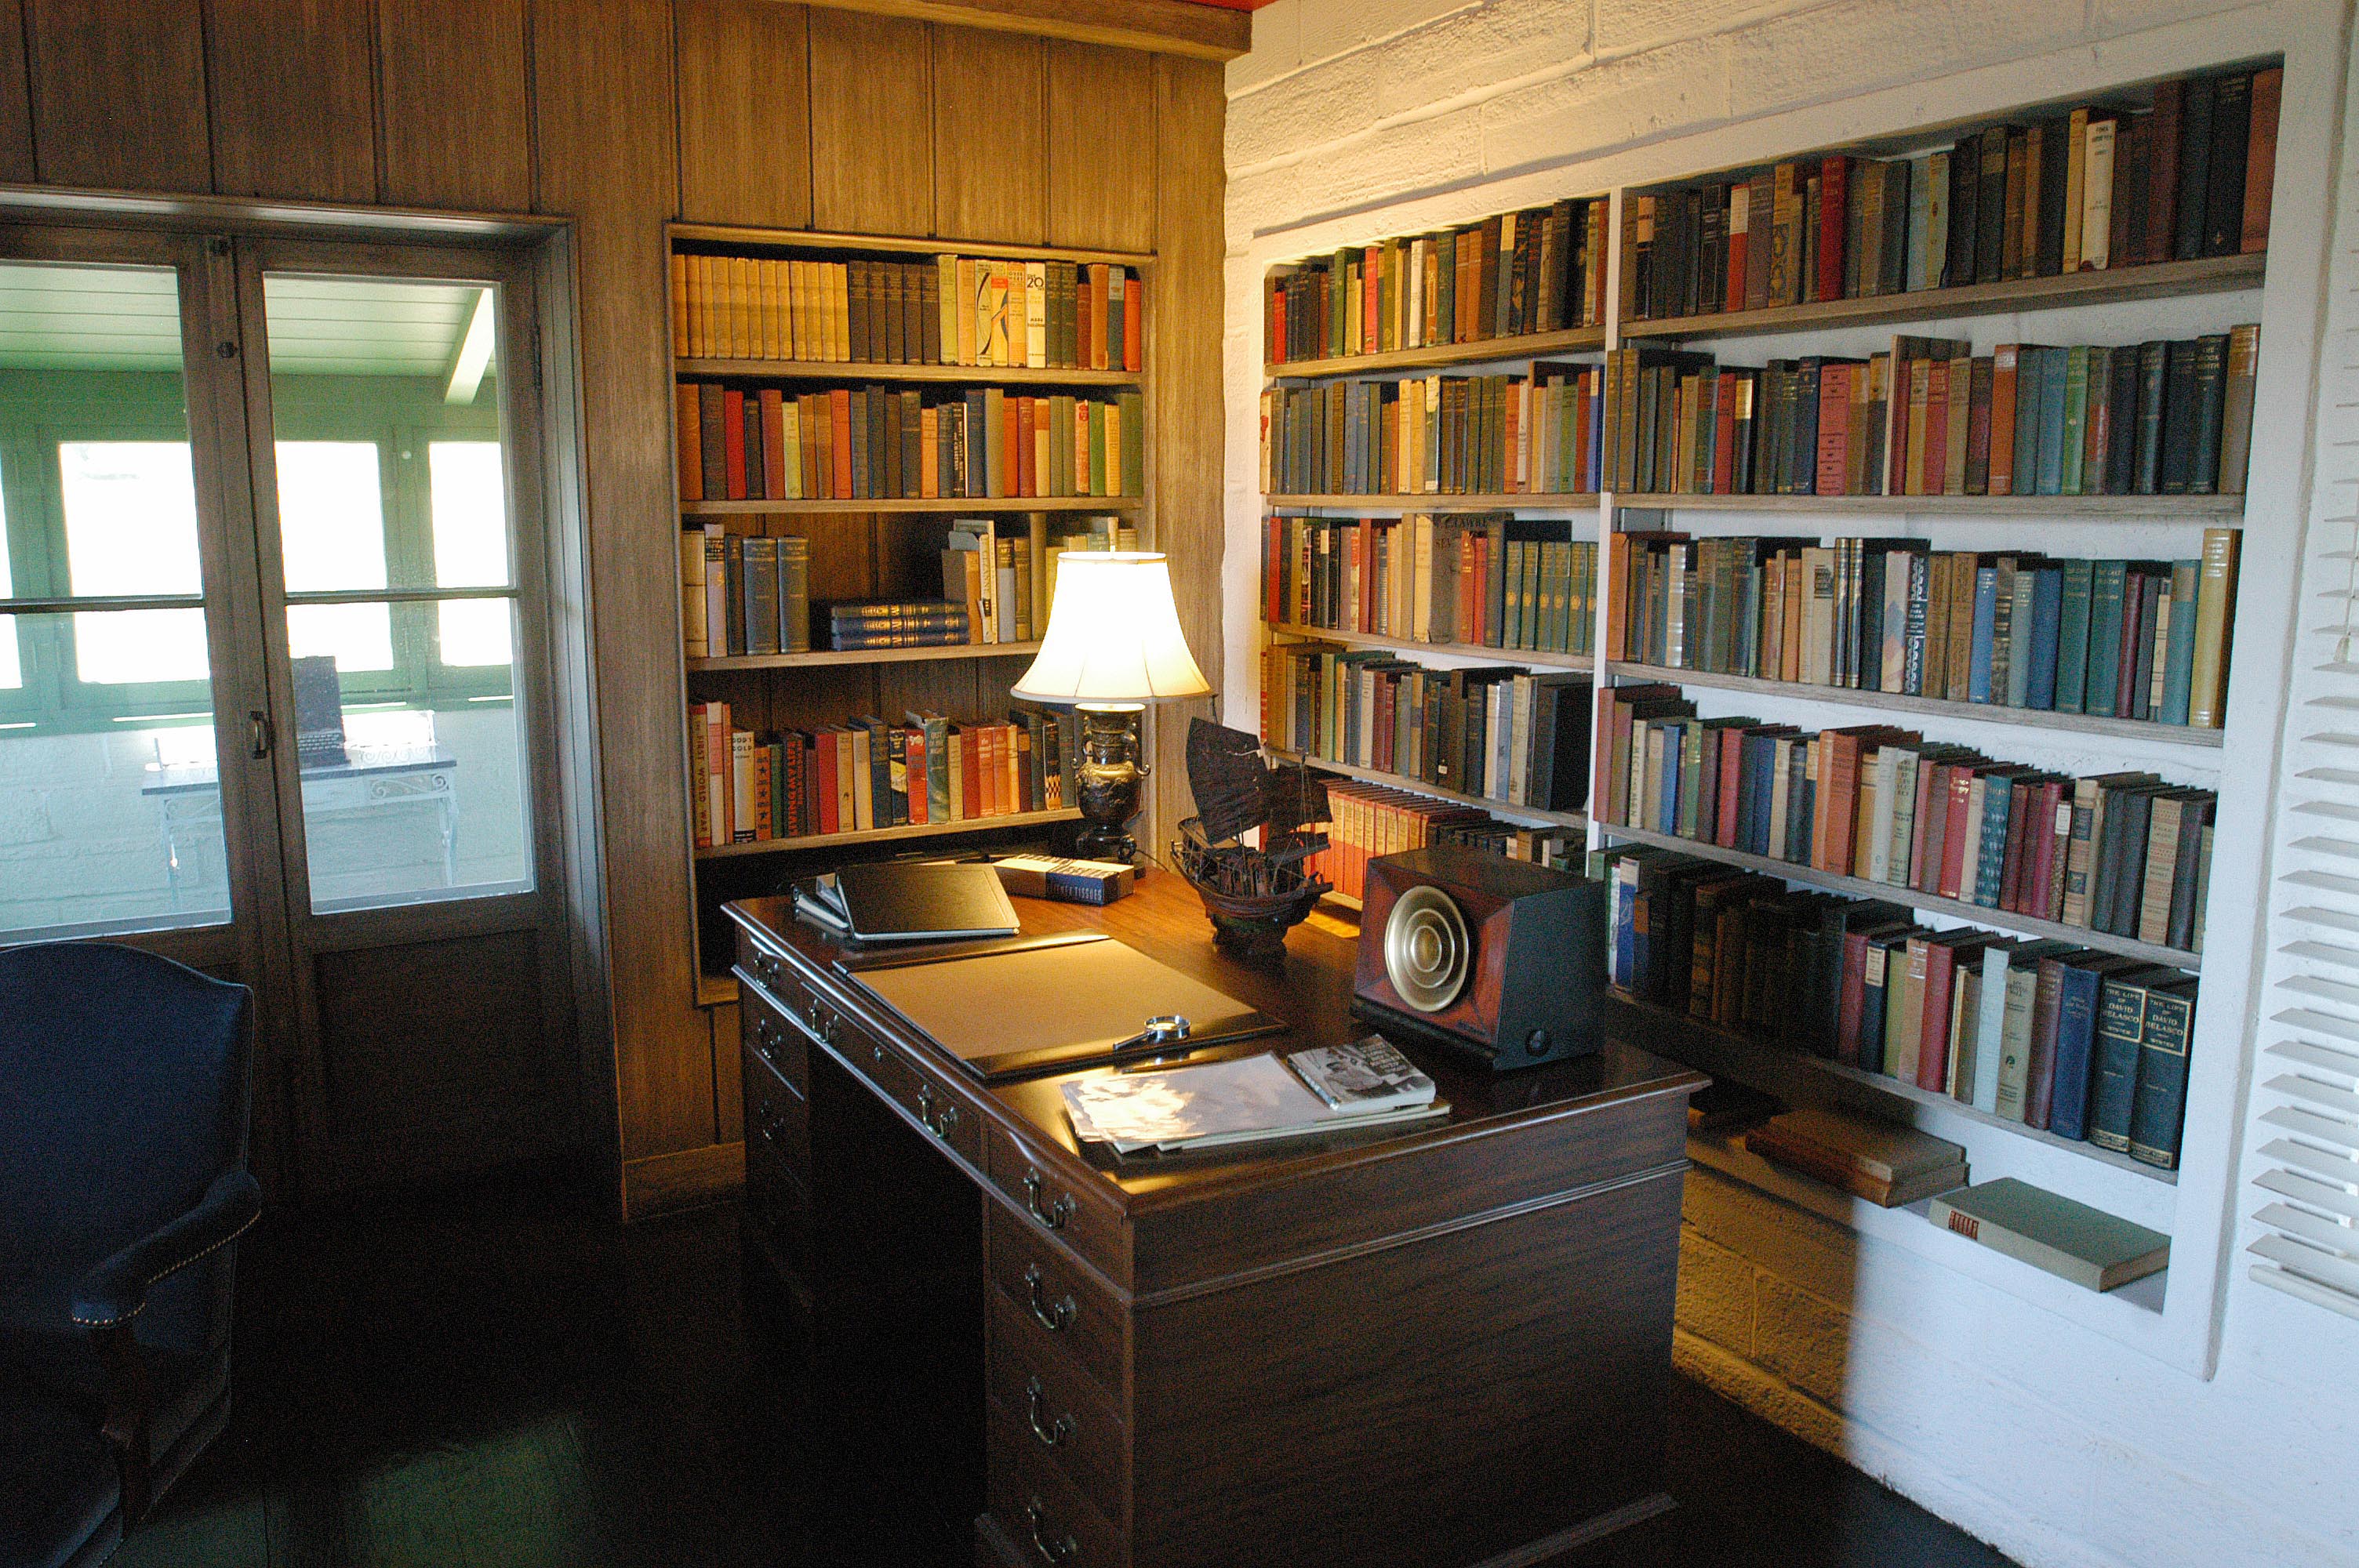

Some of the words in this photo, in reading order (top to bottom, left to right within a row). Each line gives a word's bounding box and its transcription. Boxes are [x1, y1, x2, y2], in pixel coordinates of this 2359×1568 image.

[696, 735, 705, 760] FIRST
[788, 791, 798, 837] LIVING
[1074, 886, 1102, 901] TISSUES
[2109, 1003, 2133, 1013] DAVID
[2152, 1014, 2179, 1025] DAVID
[2145, 1021, 2183, 1036] BELASCO
